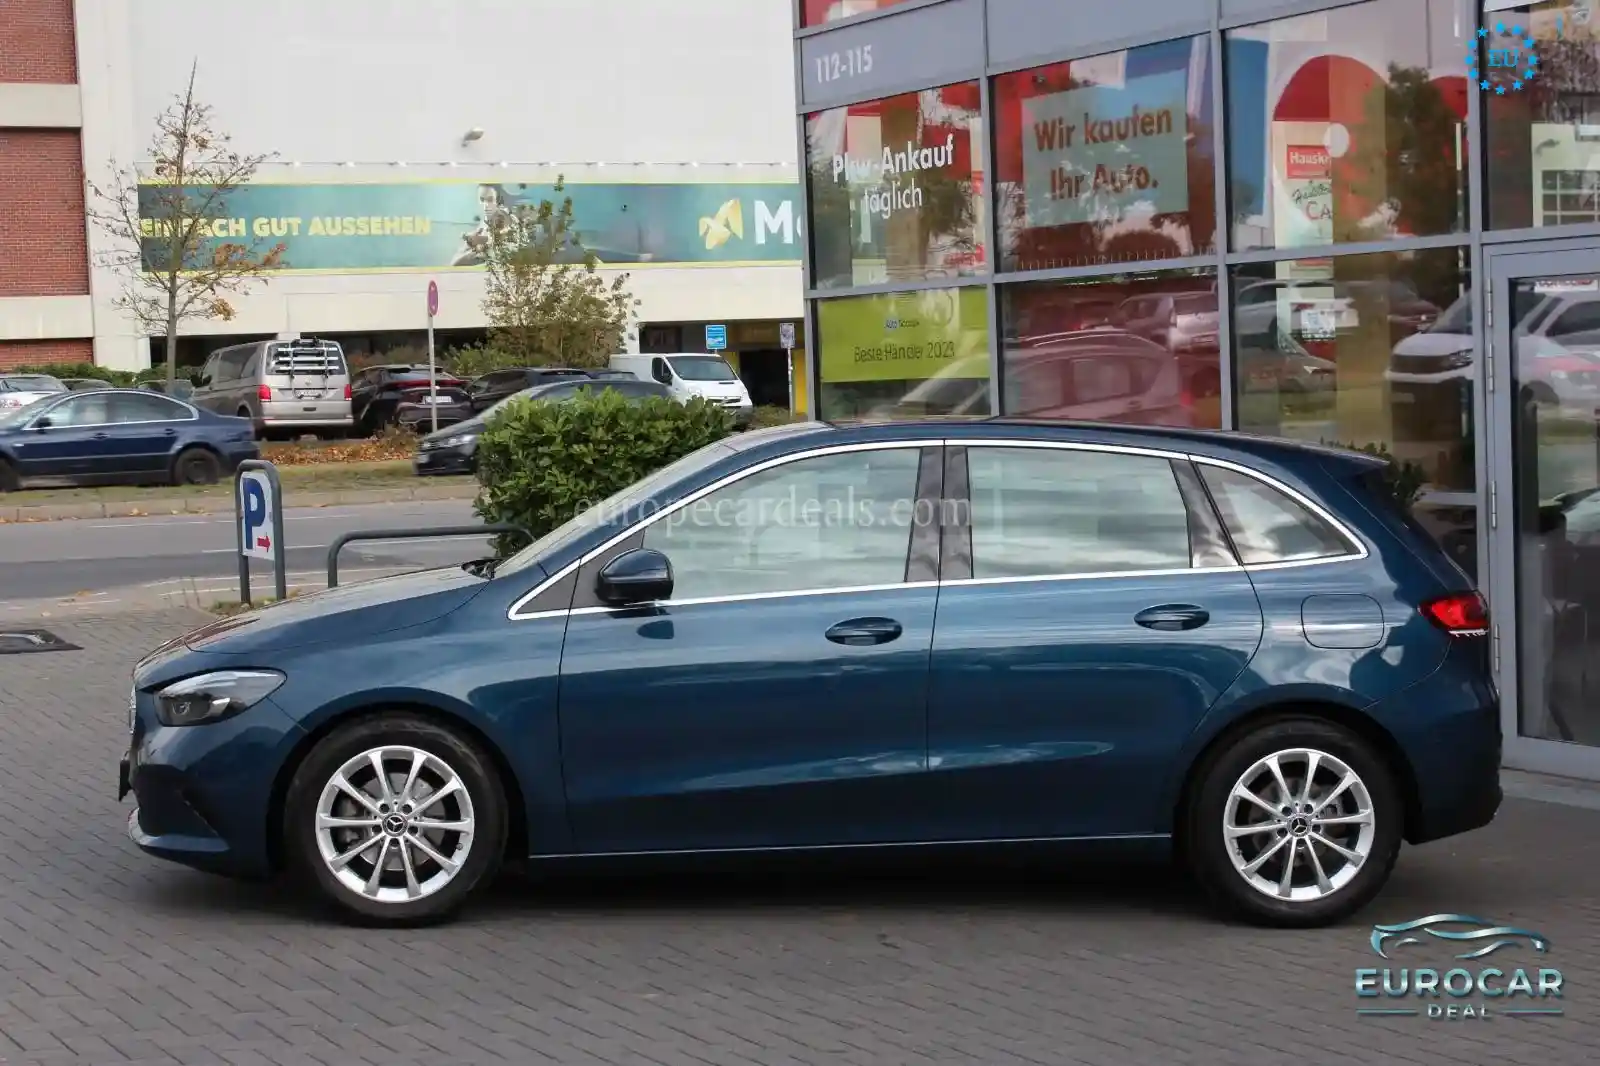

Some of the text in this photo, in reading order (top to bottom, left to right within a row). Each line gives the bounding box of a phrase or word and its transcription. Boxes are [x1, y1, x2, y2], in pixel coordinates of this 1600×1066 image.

[815, 45, 873, 83] 112-115
[1034, 104, 1172, 152] Wir kaufen
[833, 133, 954, 183] Pkw-Ankauf
[864, 177, 922, 219] täglich
[1051, 163, 1159, 200] Ihr Auto.
[252, 217, 301, 238] GUT
[308, 215, 431, 236] AUSSEHEN
[754, 200, 802, 245] M
[854, 341, 955, 362] Beste Händler 2023
[243, 478, 266, 549] P
